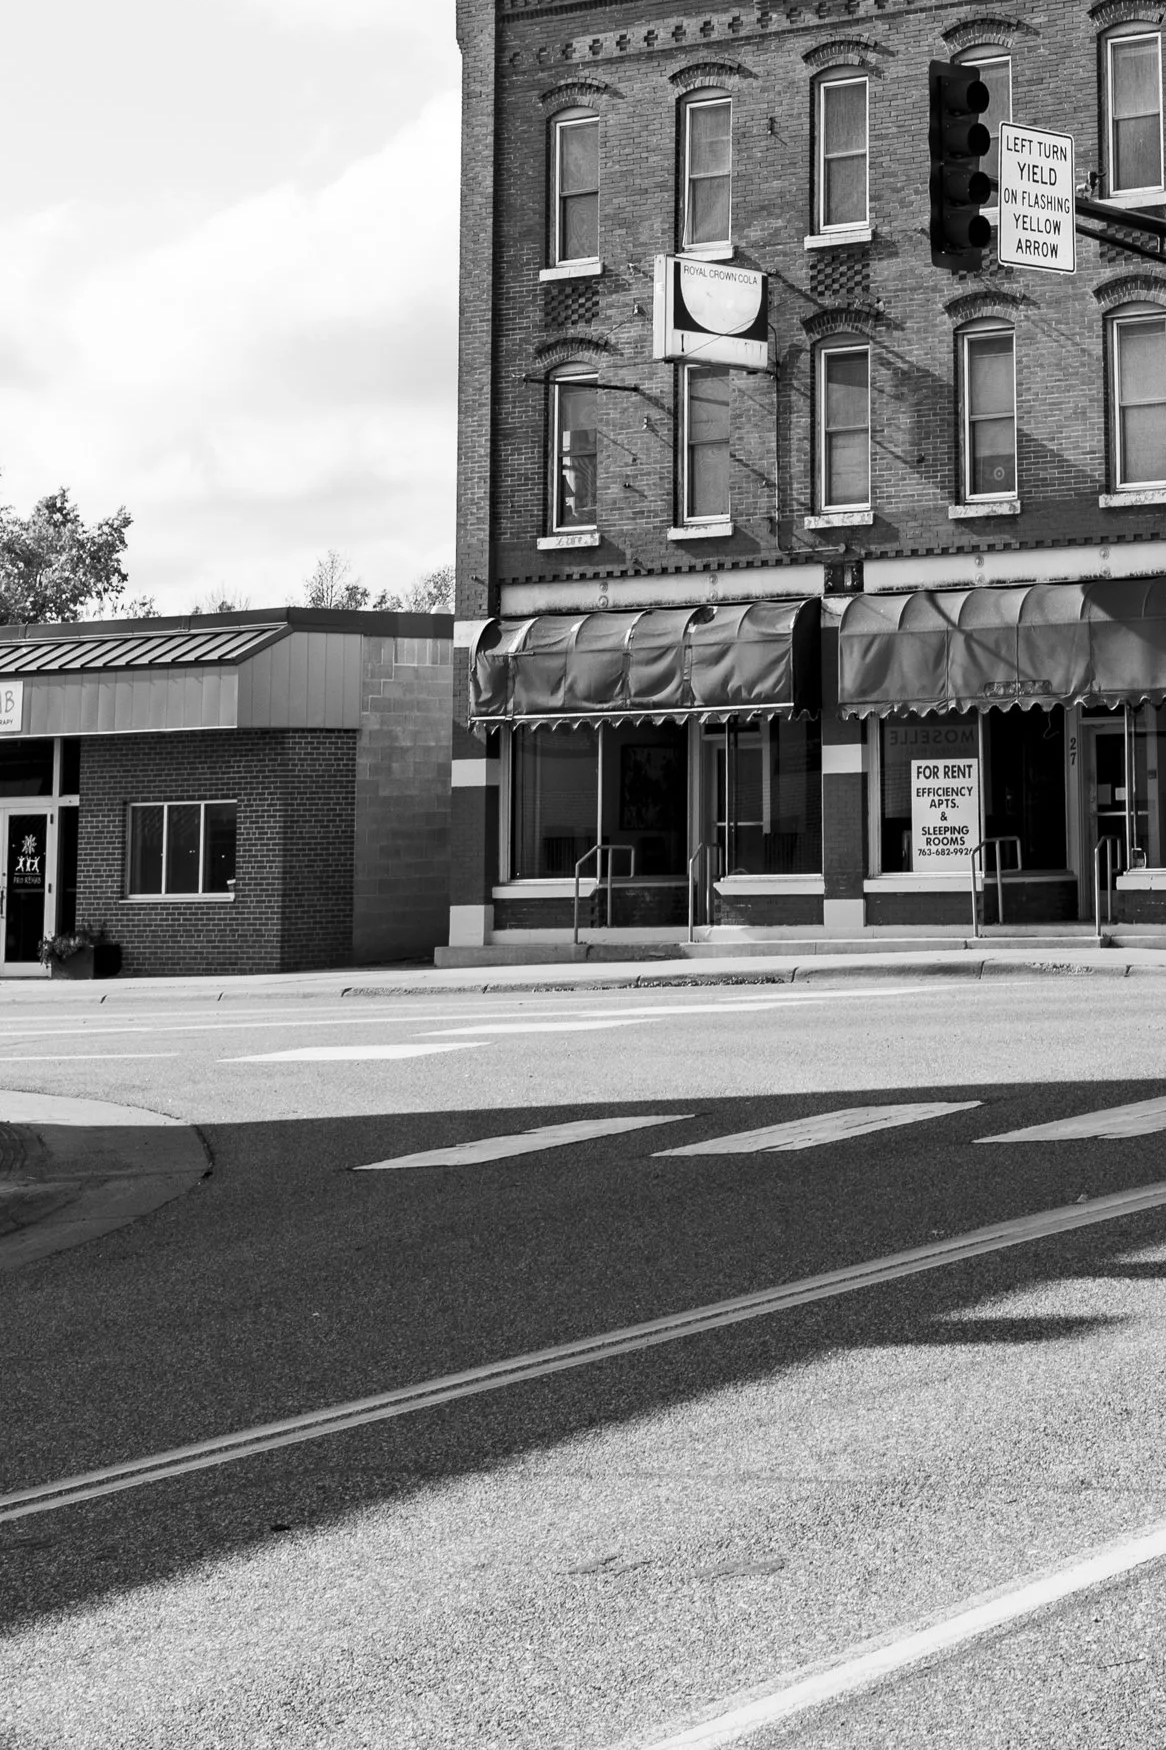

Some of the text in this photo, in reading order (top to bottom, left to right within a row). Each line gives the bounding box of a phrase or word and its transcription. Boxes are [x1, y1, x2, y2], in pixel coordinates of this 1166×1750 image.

[1006, 135, 1067, 162] LEFT TURN
[1017, 162, 1057, 186] YIELD
[1004, 187, 1070, 214] ON FLASHING
[1013, 213, 1061, 236] YELLOW
[1016, 238, 1058, 258] ARROW
[684, 265, 757, 284] ROYAL CROWN COLA
[916, 765, 972, 779] FOR RENT
[916, 787, 973, 797] EFFICIENCY
[930, 799, 959, 808] APTS.
[940, 811, 947, 821] &
[922, 826, 969, 835] SLEEPING
[926, 837, 965, 846] ROOMS
